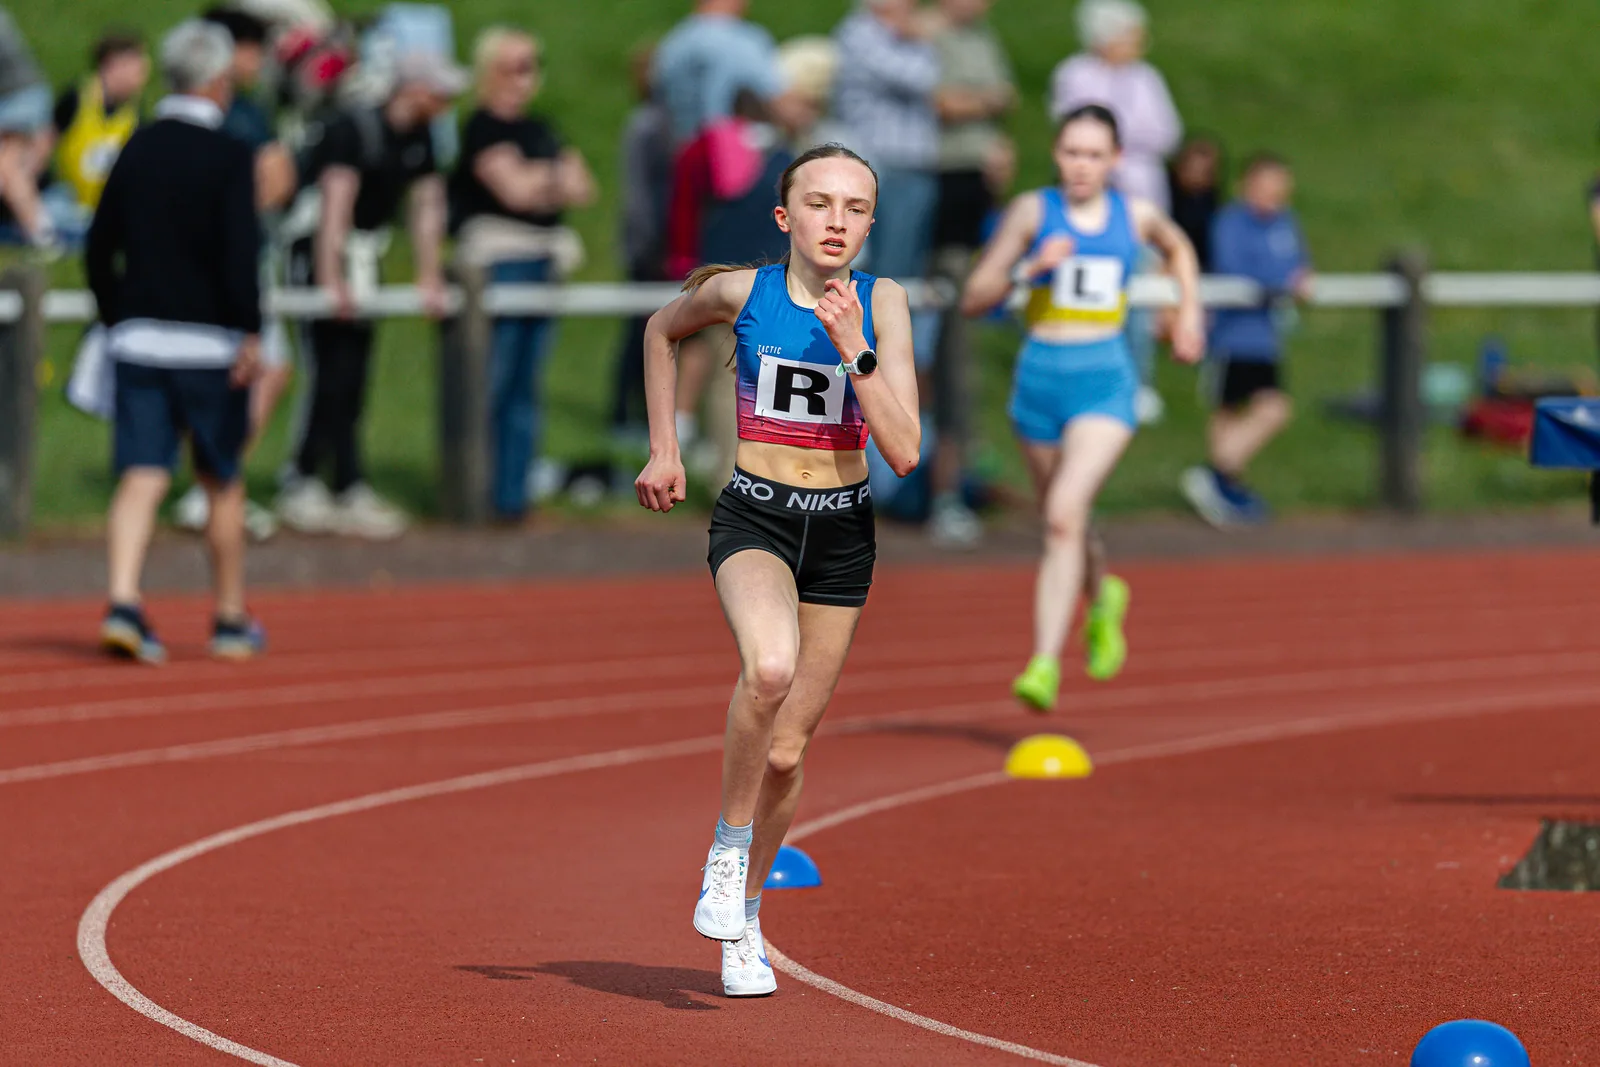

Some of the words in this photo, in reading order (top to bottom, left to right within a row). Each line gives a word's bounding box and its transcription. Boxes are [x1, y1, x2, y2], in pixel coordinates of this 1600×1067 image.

[1073, 266, 1100, 299] L
[757, 344, 782, 355] TACTIC
[773, 364, 830, 416] R
[786, 490, 854, 511] NIKE
[857, 480, 872, 505] P
